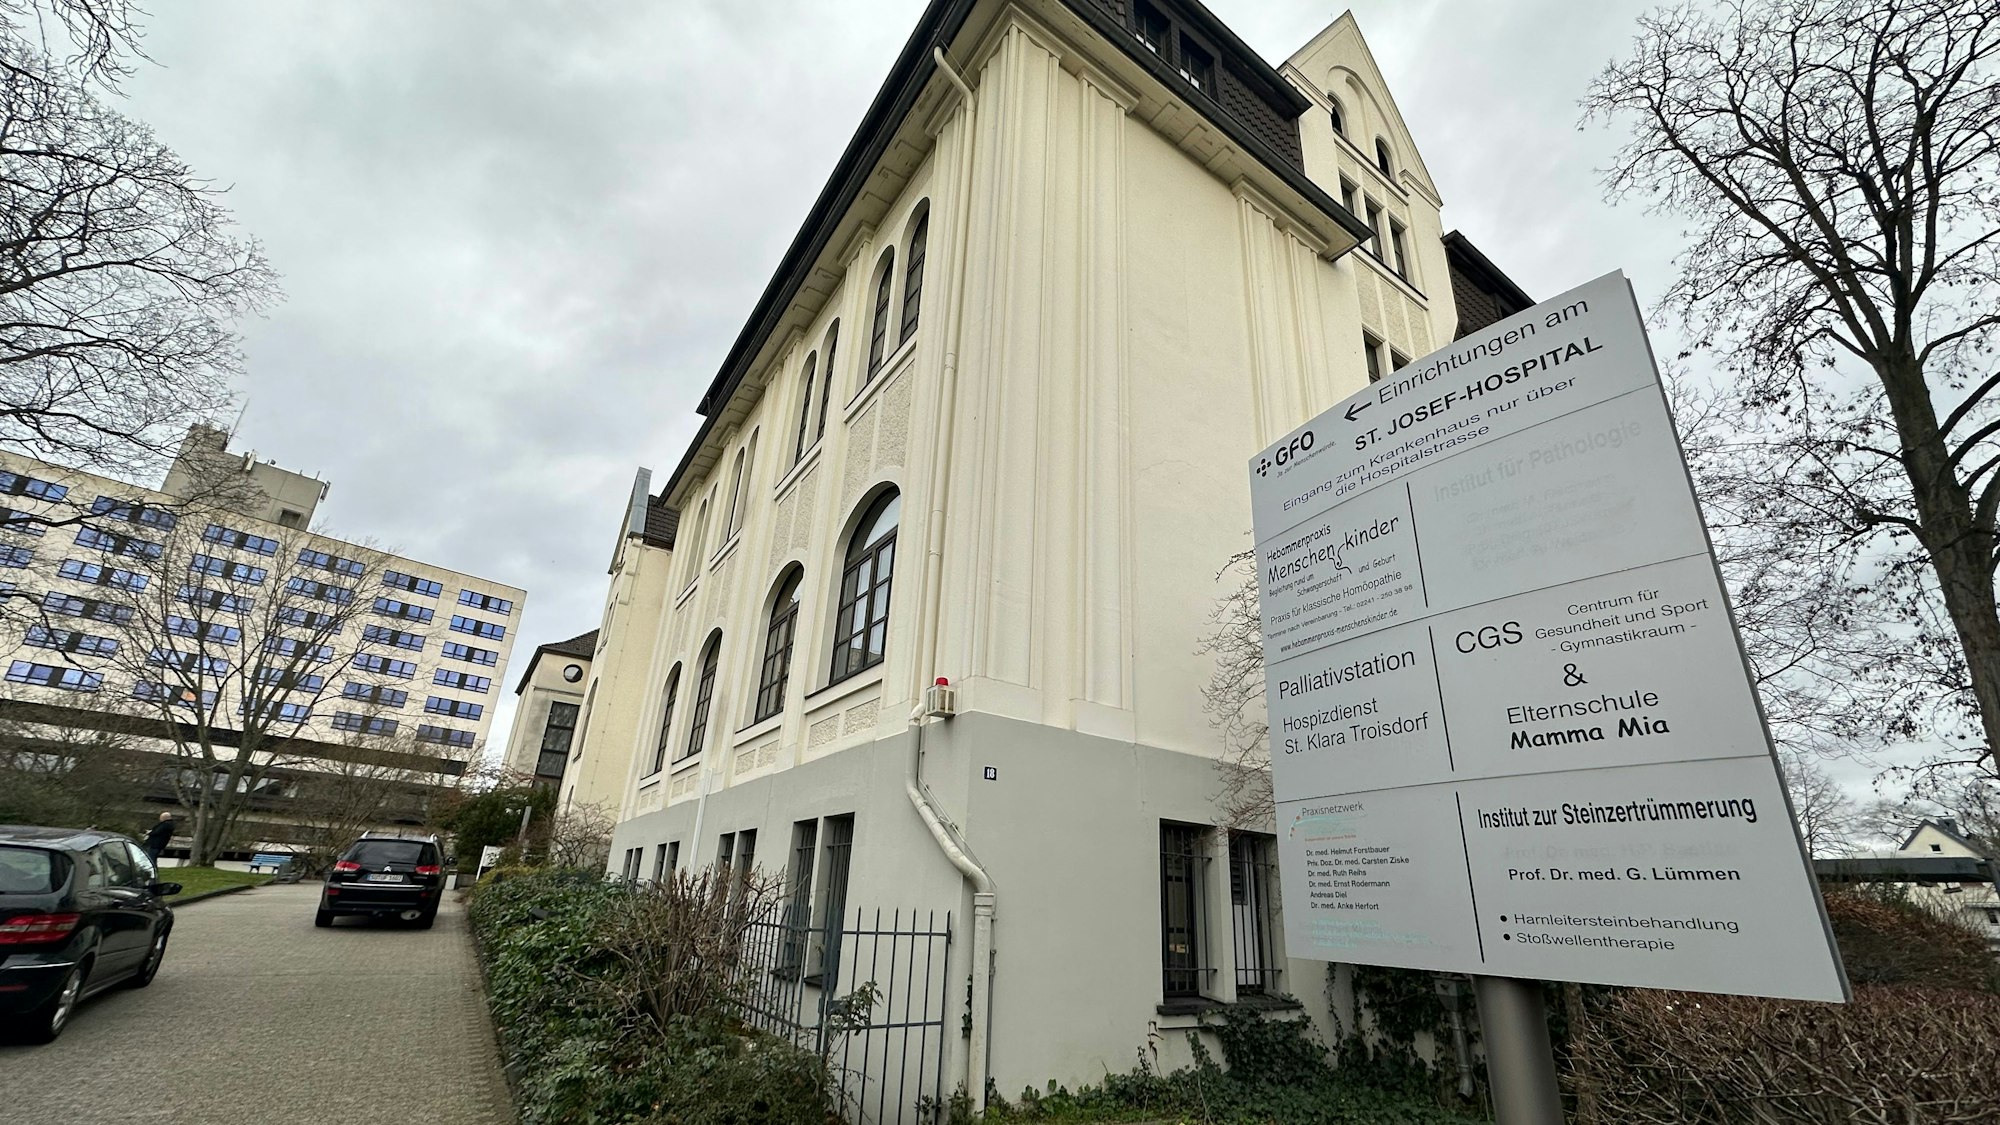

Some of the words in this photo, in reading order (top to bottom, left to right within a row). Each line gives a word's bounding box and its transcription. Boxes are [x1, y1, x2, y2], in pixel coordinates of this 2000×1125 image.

[1378, 323, 1536, 404] Einrichtungen
[1545, 300, 1589, 328] am
[1355, 428, 1382, 451] ST.
[1387, 337, 1603, 435] JOSEF-HOSPITAL
[1275, 431, 1314, 466] GFO
[1283, 480, 1332, 512] Eingang
[1336, 465, 1365, 484] zum
[1369, 414, 1481, 467] Krankenhaus
[1487, 398, 1519, 417] nur
[1526, 377, 1576, 402] über
[1335, 482, 1356, 497] die
[1360, 425, 1489, 485] Hospitalstrasse
[1528, 419, 1642, 470] Pathologie
[1266, 524, 1332, 563] Hebammenpraxis
[1268, 579, 1294, 598] Begleitung
[1294, 576, 1306, 586] rund
[1307, 573, 1315, 582] um
[1296, 573, 1342, 597] Schwangerschaft
[1358, 563, 1370, 573] und
[1373, 553, 1396, 569] Geburt
[1270, 610, 1291, 625] Praxis
[1291, 605, 1301, 617] für
[1302, 591, 1341, 612] klassische
[1343, 571, 1402, 599] Homöopathie
[1567, 594, 1633, 616] Centrum
[1637, 588, 1659, 602] für
[1535, 614, 1620, 640] Gesundheit
[1625, 608, 1656, 624] und
[1661, 598, 1709, 619] Sport
[1455, 621, 1523, 654] CGS
[1560, 622, 1685, 655] Gymnastikraum
[1279, 650, 1416, 699] Palliativstation
[1563, 663, 1588, 687] &
[1283, 698, 1378, 733] Hospizdienst
[1507, 690, 1659, 725] Elternschule
[1285, 739, 1303, 755] St.
[1307, 732, 1345, 750] Klara
[1349, 711, 1428, 742] Troisdorf
[1510, 726, 1605, 750] Mamma
[1618, 716, 1670, 738] Mia
[985, 768, 996, 779] 18
[1301, 801, 1365, 817] Praxisnetzwerk
[1478, 807, 1528, 828] Institut
[1532, 808, 1557, 826] zur
[1563, 797, 1758, 825] Steinzertrümmerung
[1331, 847, 1353, 855] Helmut
[1344, 858, 1360, 866] med.
[1361, 857, 1389, 865] Carsten
[1389, 856, 1410, 864] Ziske
[1332, 869, 1347, 877] Ruth
[1508, 868, 1546, 881] Prof.
[1550, 868, 1574, 881] Dr.
[1578, 868, 1621, 881] med.
[1626, 867, 1647, 881] G.
[1652, 866, 1741, 881] Lümmen
[1337, 902, 1354, 910] Anke
[1355, 902, 1379, 910] Herfort
[1514, 914, 1739, 934] Harnleitersteinbehandlung
[1517, 932, 1675, 952] Stoßwellentherapie
